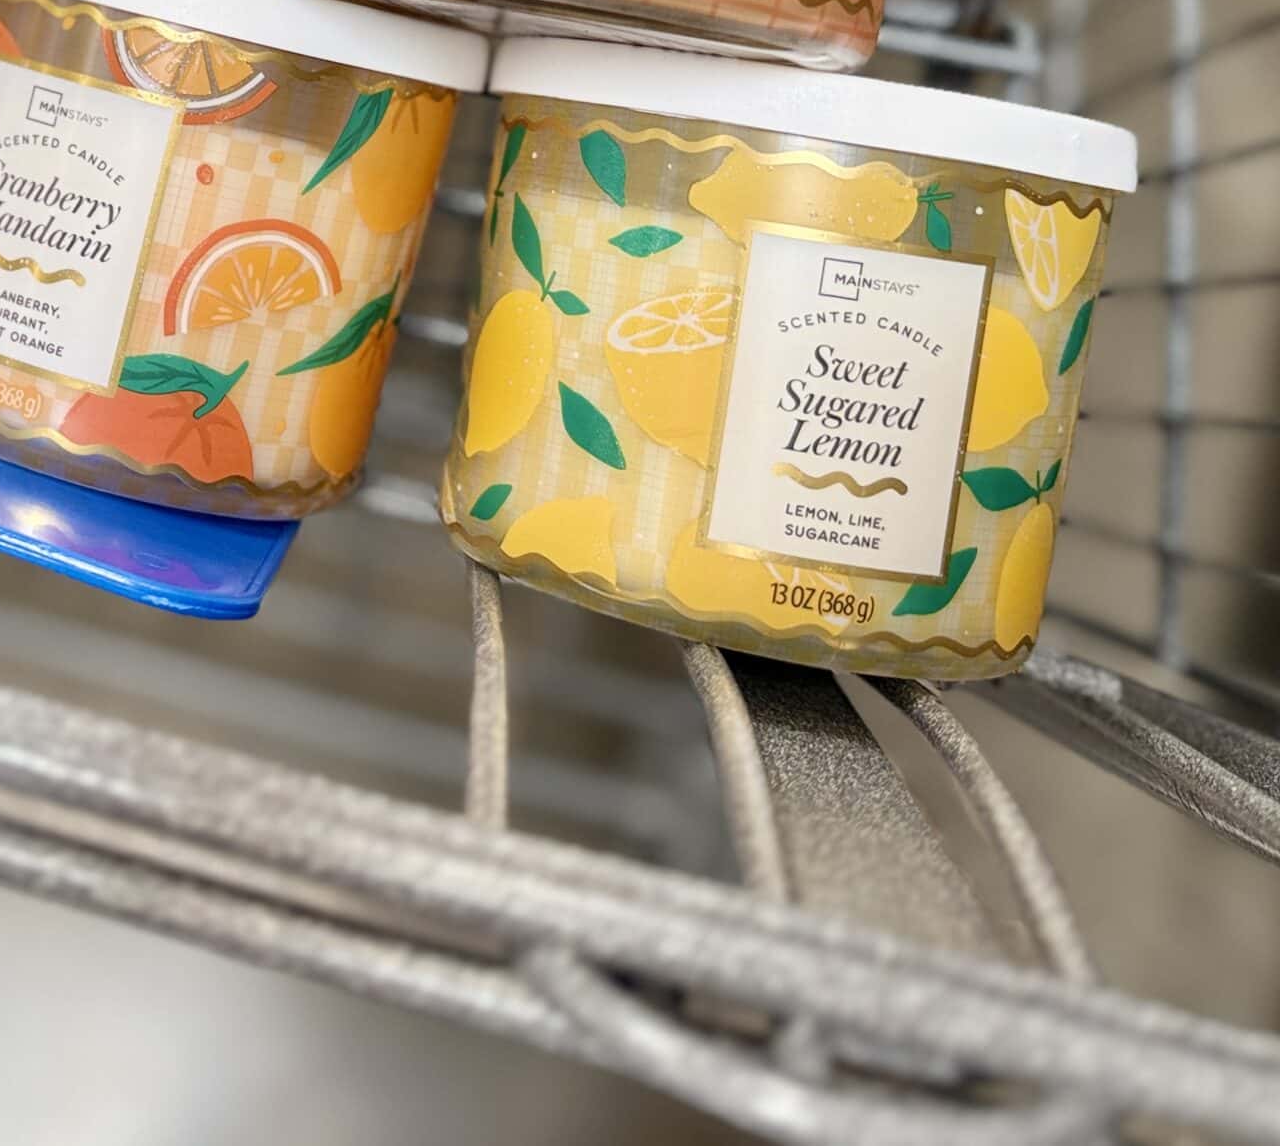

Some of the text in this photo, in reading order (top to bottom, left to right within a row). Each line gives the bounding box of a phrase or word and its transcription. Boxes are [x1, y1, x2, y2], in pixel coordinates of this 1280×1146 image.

[39, 101, 103, 127] MAINSTAYS
[67, 144, 126, 187] CANDLE
[834, 273, 914, 295] MAINSTAYS
[10, 331, 64, 357] ORANGE
[778, 311, 943, 357] SCENTED CANDLE
[806, 344, 910, 389] Sweet
[23, 394, 41, 418] g)
[777, 379, 925, 431] Sugared
[784, 419, 903, 467] Lemon
[785, 504, 885, 531] LEMON, LIME,
[785, 524, 880, 549] SUGARCANE
[771, 582, 875, 623] 13 OZ (368 g)
